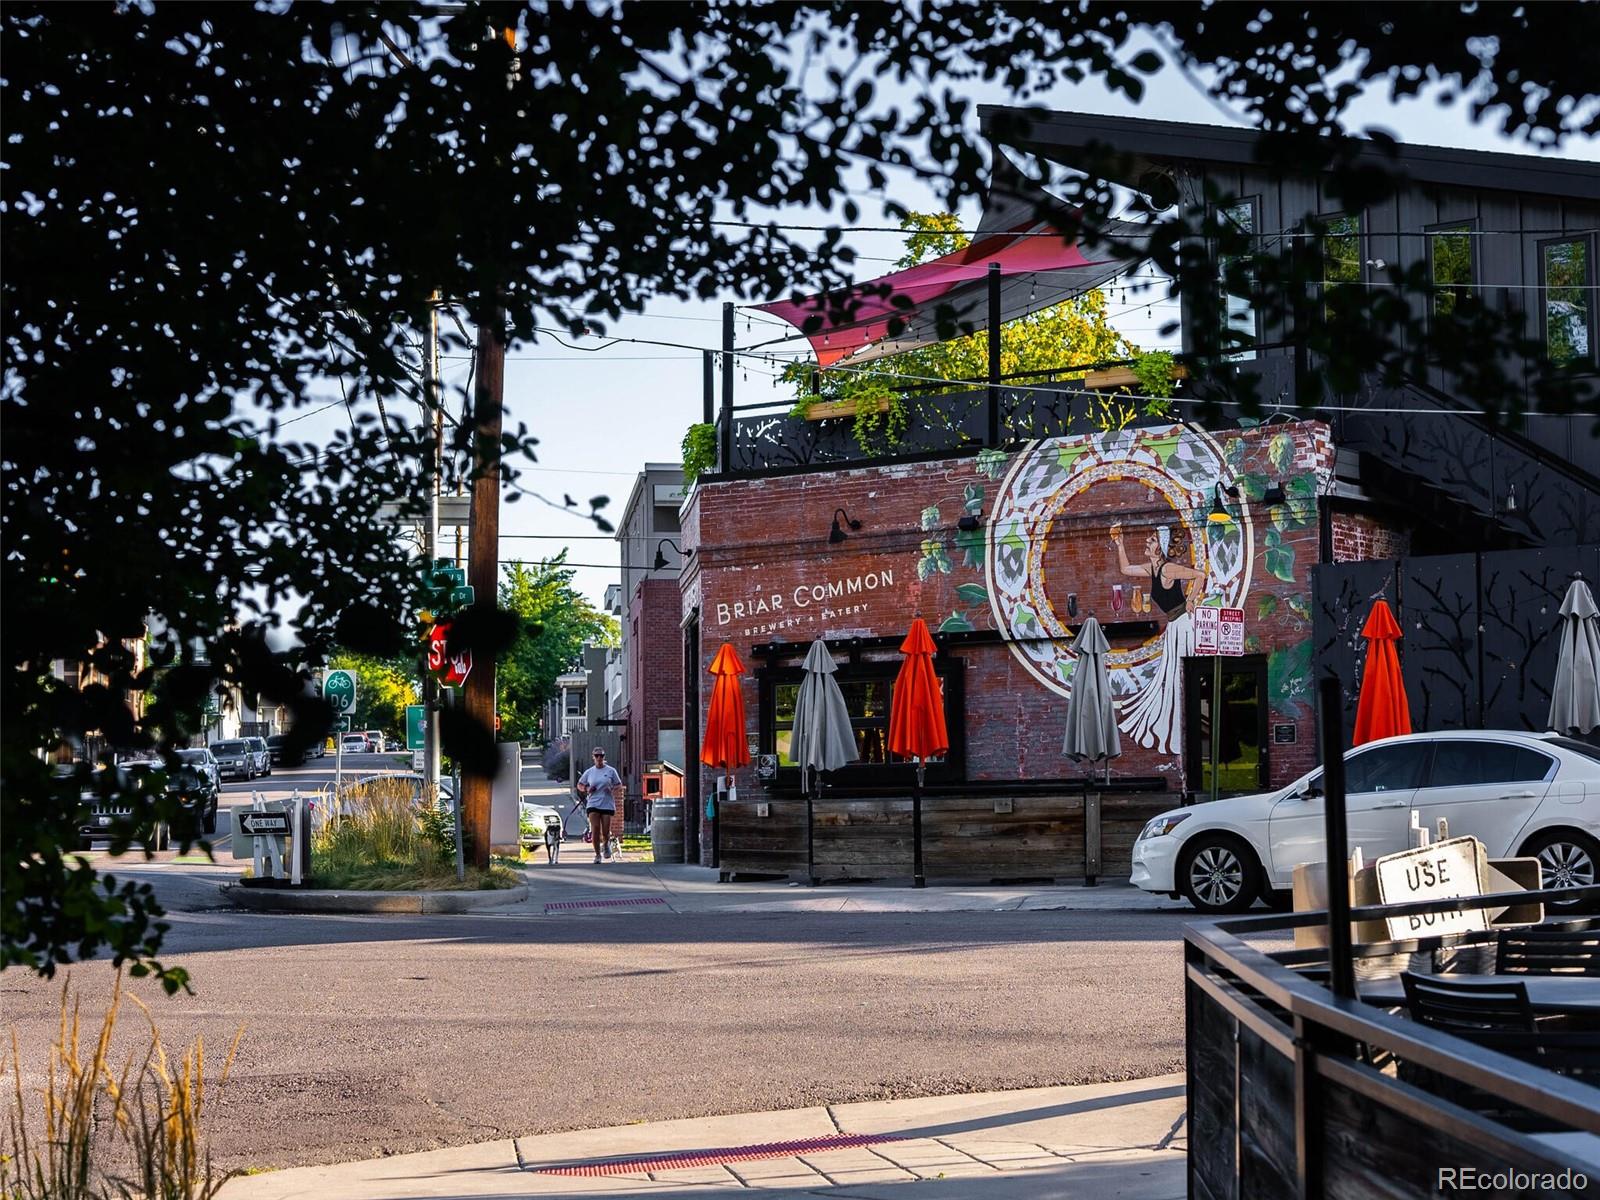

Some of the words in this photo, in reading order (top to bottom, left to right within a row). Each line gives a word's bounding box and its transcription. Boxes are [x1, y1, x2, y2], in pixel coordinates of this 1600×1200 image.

[717, 594, 783, 626] BRIAR
[794, 569, 894, 608] COMMON
[744, 617, 801, 636] BREWERY
[821, 603, 869, 620] EATERY
[1202, 610, 1212, 619] NO
[1196, 620, 1217, 630] PARKING
[331, 694, 349, 708] D6
[251, 820, 263, 828] ONE
[265, 819, 277, 827] WAY
[1406, 859, 1450, 891] USE
